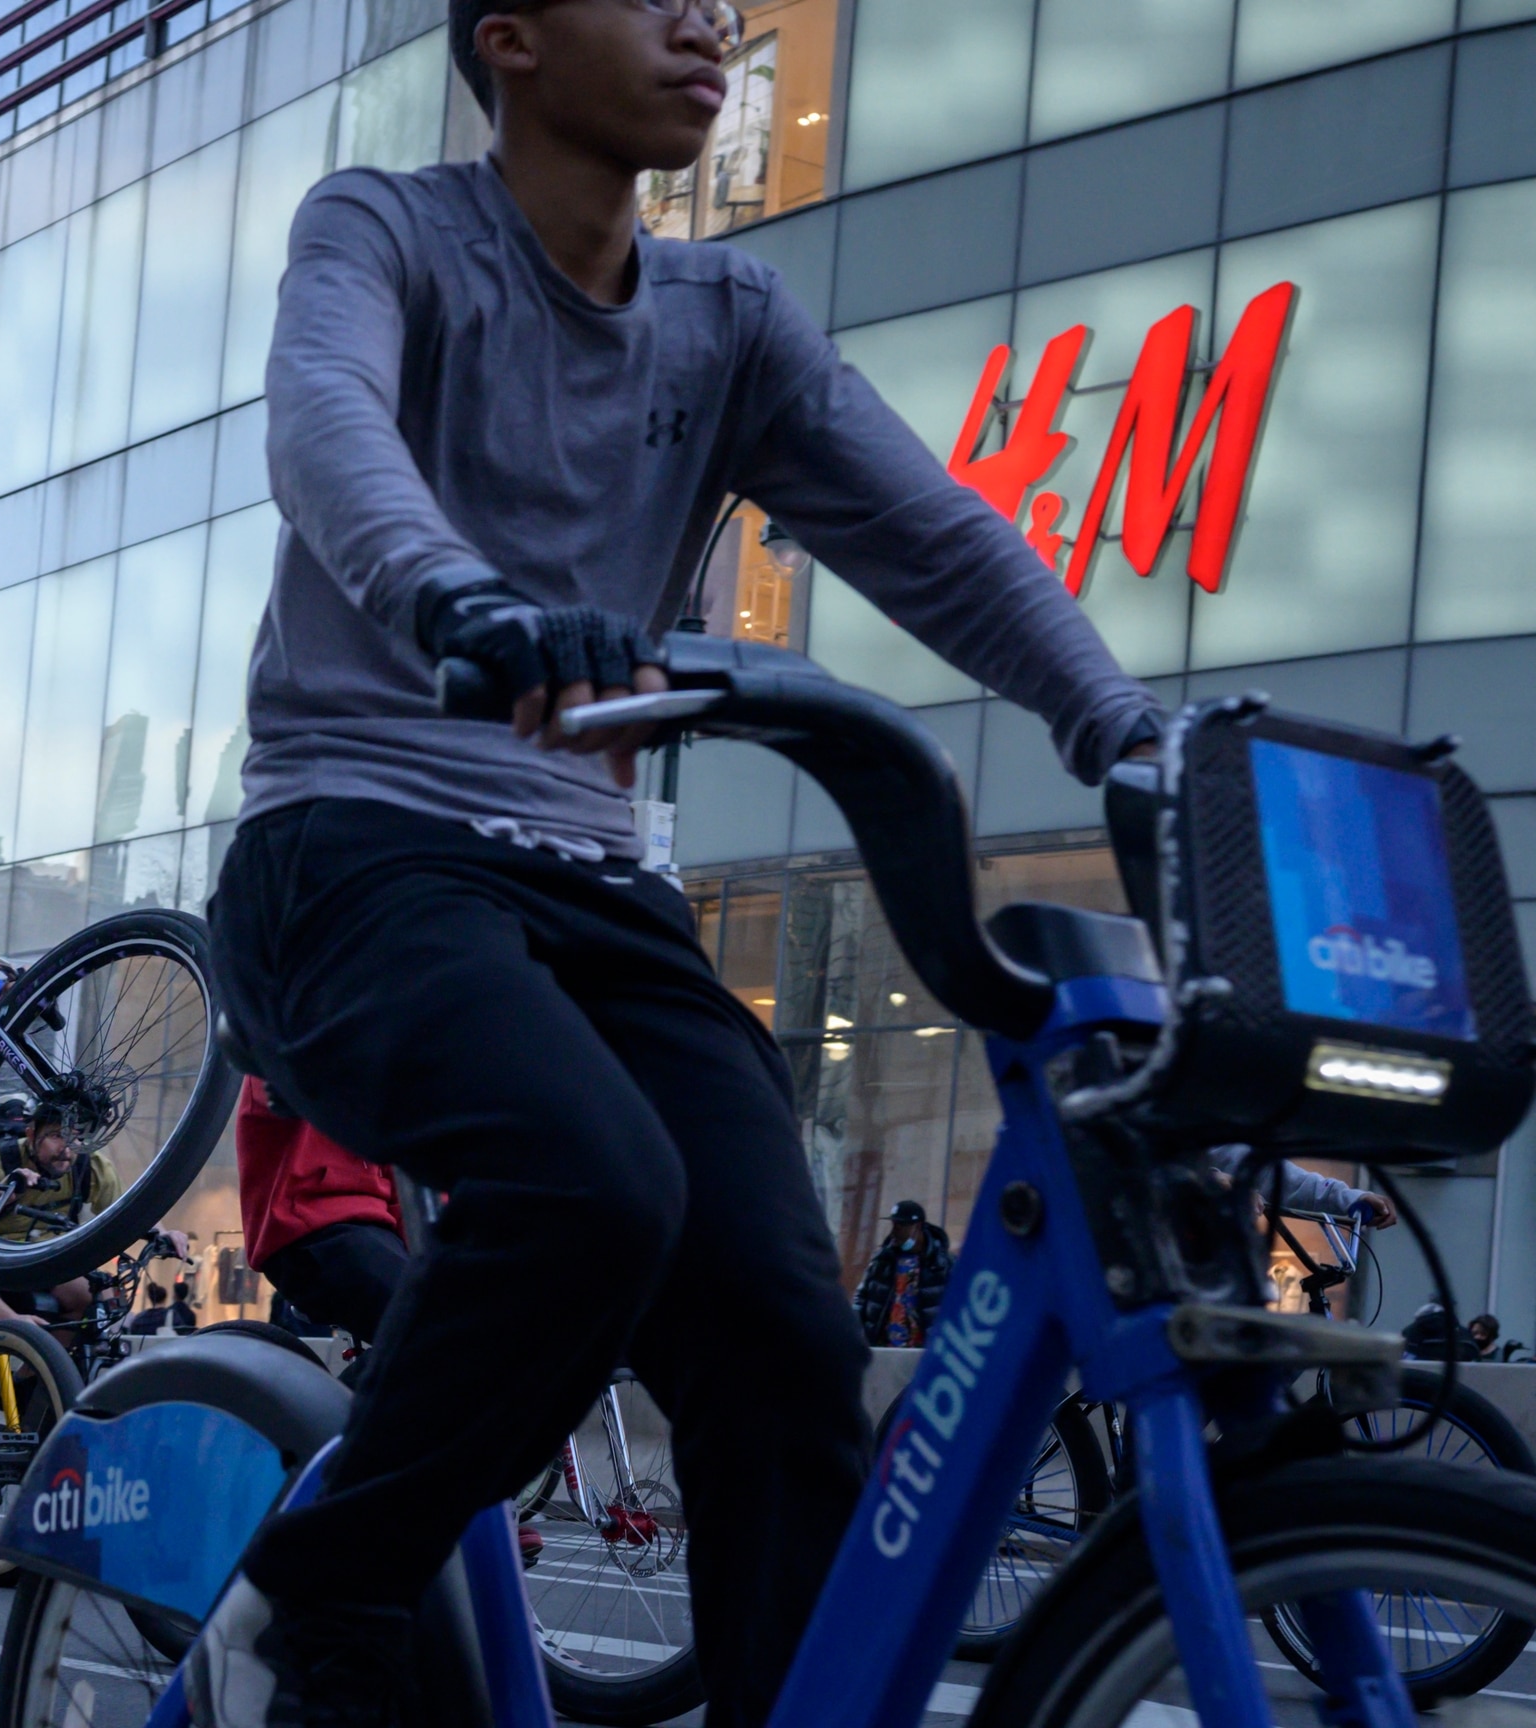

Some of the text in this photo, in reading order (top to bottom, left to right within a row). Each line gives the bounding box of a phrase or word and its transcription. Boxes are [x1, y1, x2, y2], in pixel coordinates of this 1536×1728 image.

[946, 280, 1296, 600] H&M
[33, 1465, 151, 1534] citi bike
[872, 1269, 1011, 1559] citi bike
